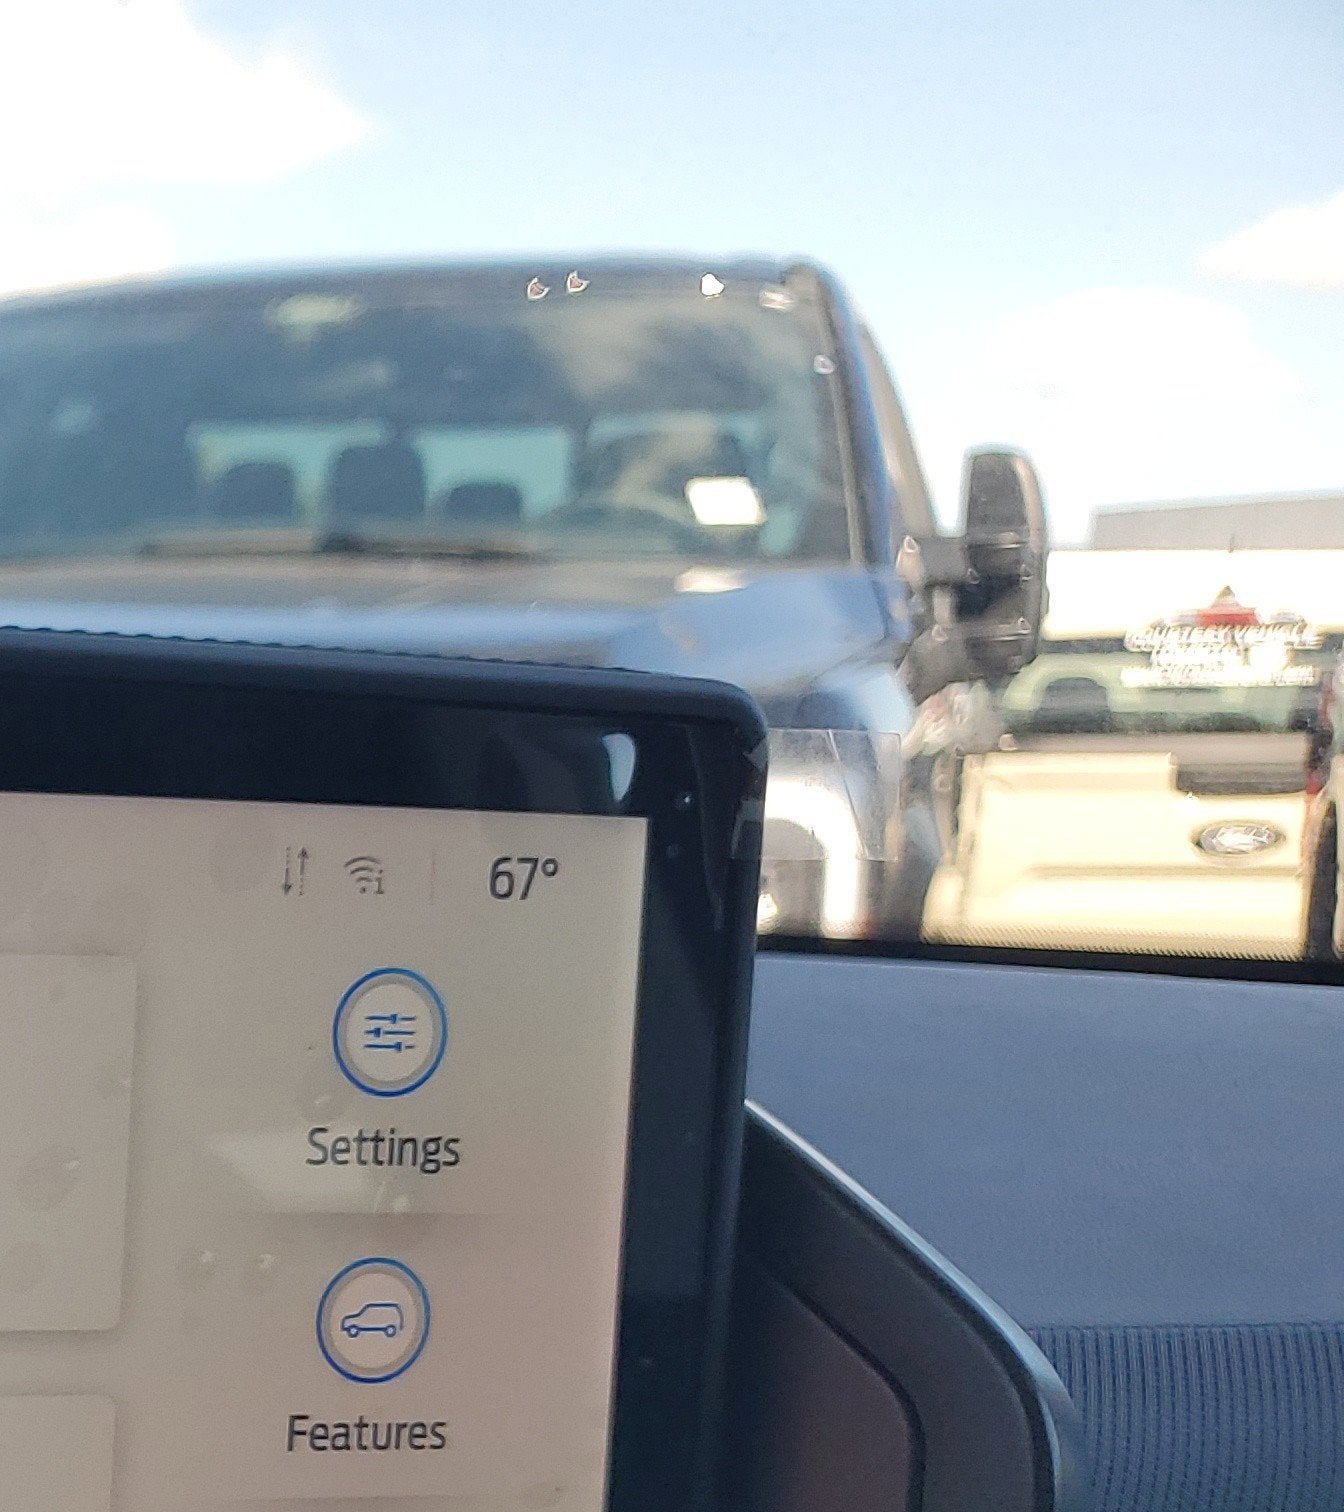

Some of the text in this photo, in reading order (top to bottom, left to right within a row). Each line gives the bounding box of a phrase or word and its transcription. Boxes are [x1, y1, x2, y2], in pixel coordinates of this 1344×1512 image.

[489, 857, 559, 900] 67°
[306, 1127, 461, 1175] Settings
[286, 1415, 448, 1452] Features
